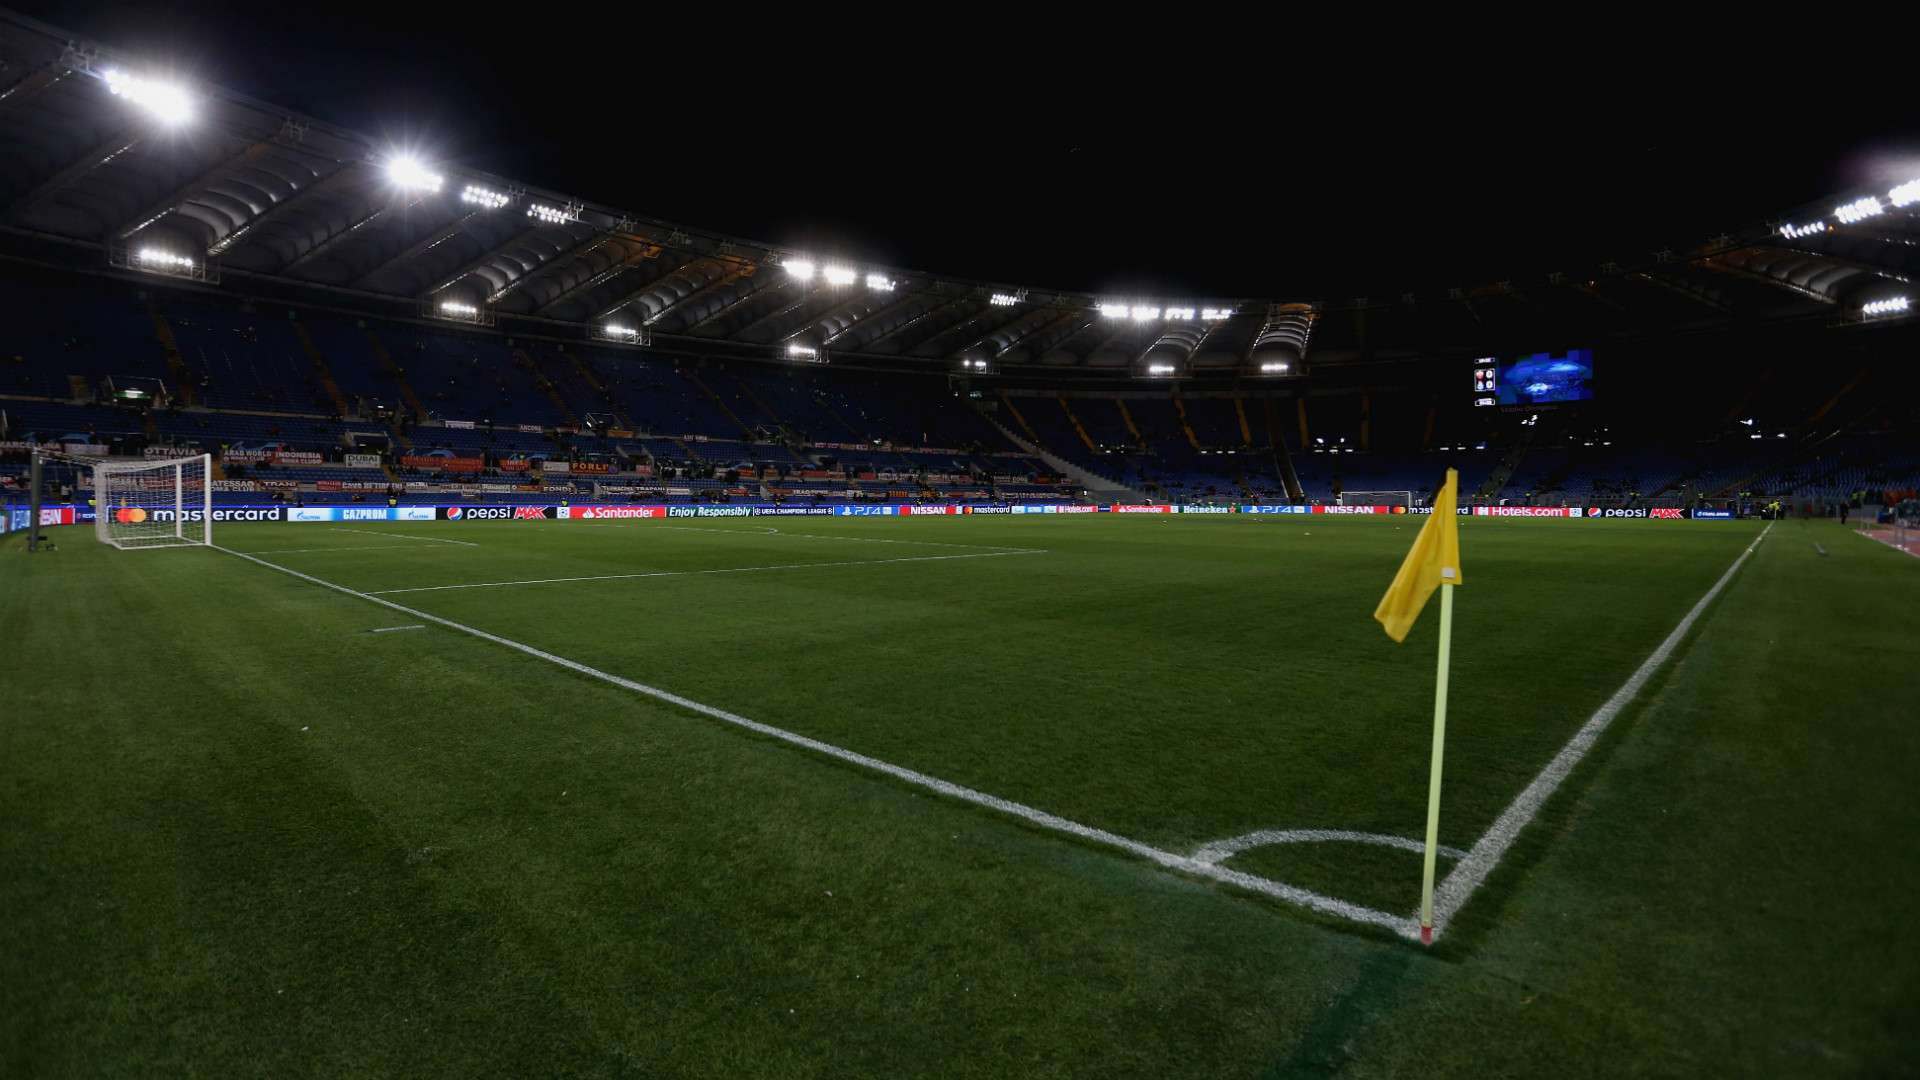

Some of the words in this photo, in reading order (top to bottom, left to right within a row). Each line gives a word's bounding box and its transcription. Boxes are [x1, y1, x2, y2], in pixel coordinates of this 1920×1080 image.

[144, 447, 197, 456] OTTAVIA
[275, 451, 321, 459] INDONESIA
[343, 509, 387, 520] GAZPROM
[467, 507, 510, 520] pepsi
[513, 506, 547, 520] MAX
[595, 507, 655, 518] Santander
[669, 507, 696, 517] Enjoy
[697, 507, 750, 517] Responsibly
[855, 507, 880, 515] PS4
[911, 506, 946, 515] NISSAN
[1492, 507, 1562, 516] Hotels.com
[1605, 509, 1646, 517] pepsi
[1648, 508, 1685, 519] MAX
